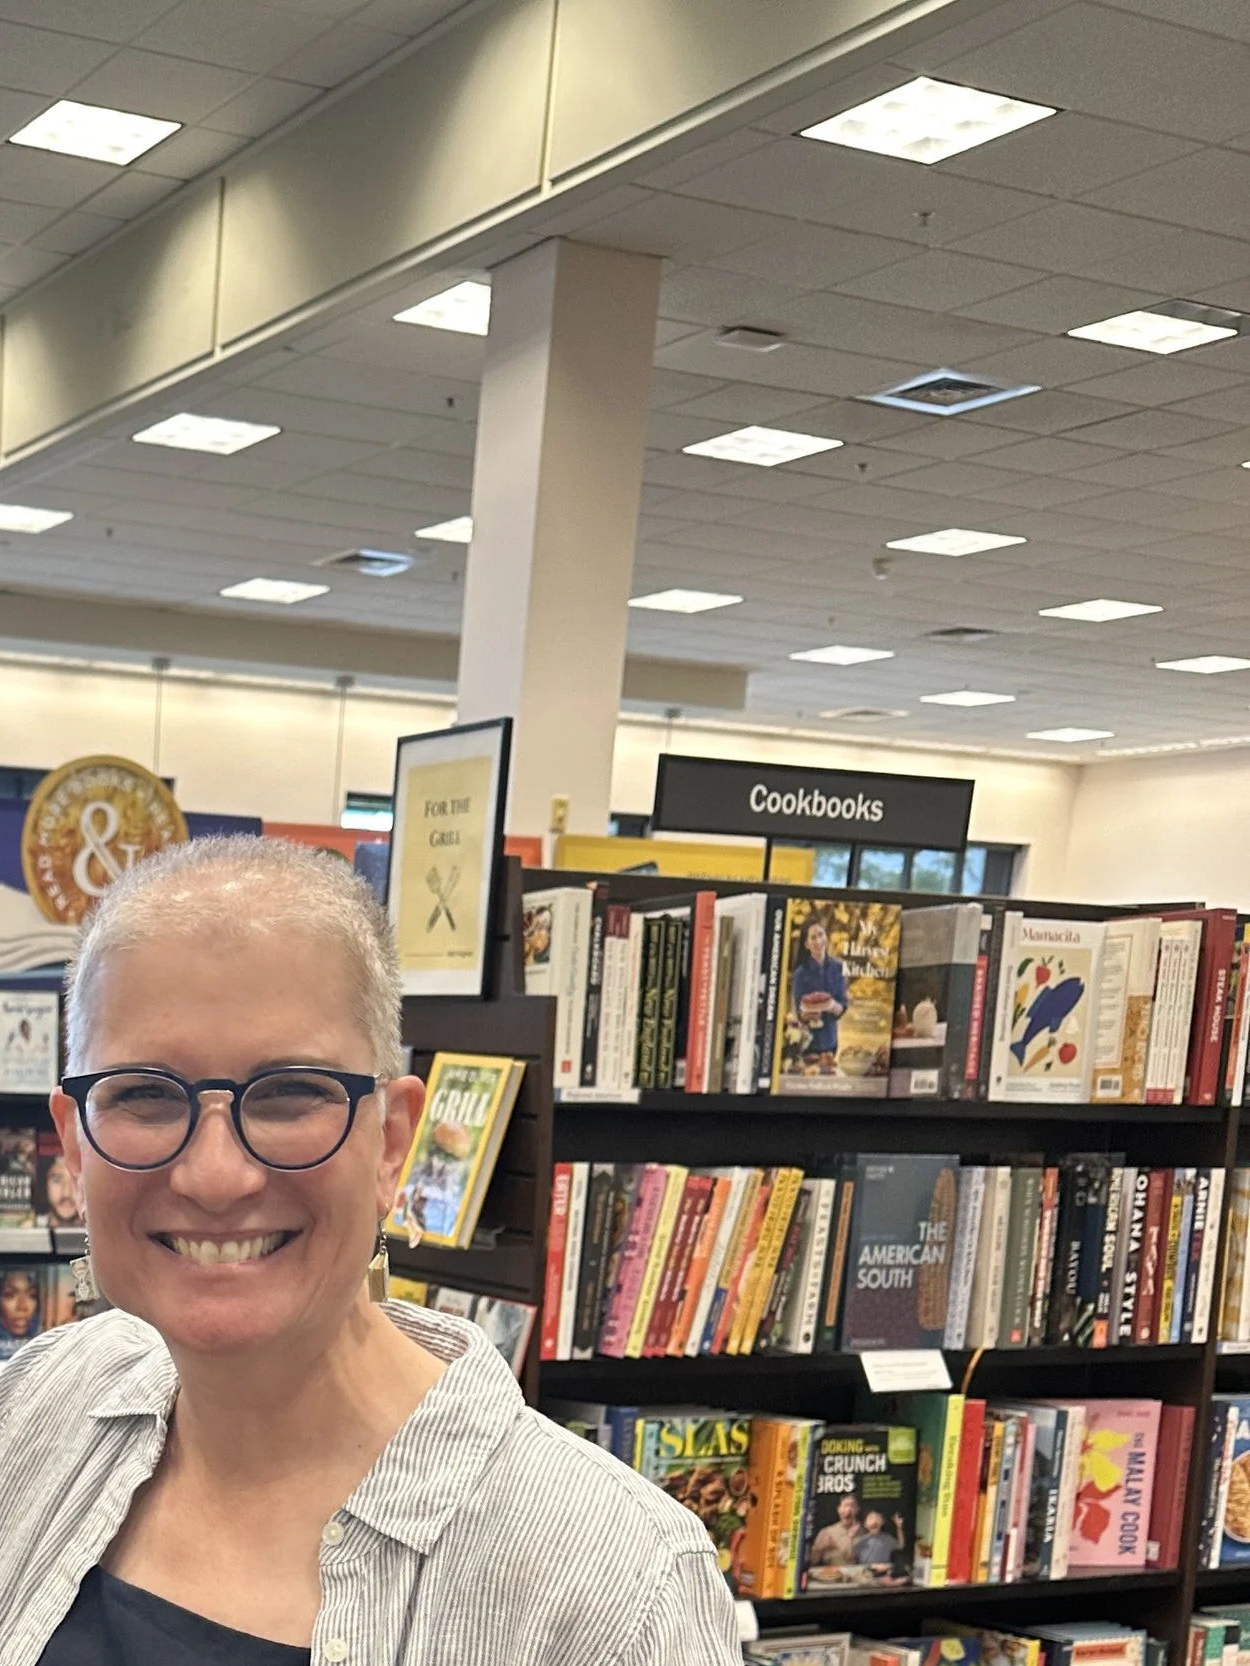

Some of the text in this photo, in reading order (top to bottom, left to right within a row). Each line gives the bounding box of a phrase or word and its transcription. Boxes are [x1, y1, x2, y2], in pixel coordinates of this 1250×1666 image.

[425, 798, 470, 818] FOR THE
[750, 784, 884, 822] Cookbooks
[429, 830, 461, 848] GRILL
[1022, 927, 1081, 944] Mamacita
[768, 932, 780, 982] AMERICAN
[842, 961, 888, 978] Kitchen
[765, 984, 776, 1020] DREAM
[1210, 969, 1227, 1043] STEAK HOUSE
[430, 1087, 490, 1129] GRILL
[552, 1174, 568, 1215] EATER
[919, 1222, 947, 1241] THE
[1102, 1168, 1124, 1272] AMERICAN SOUL
[859, 1245, 946, 1265] AMERICAN
[1066, 1240, 1081, 1295] BAYOU
[1119, 1175, 1148, 1337] OHANA STYLE
[857, 1269, 913, 1289] SOUTH
[824, 1453, 886, 1474] CRUNCH
[1123, 1452, 1146, 1505] MALAY
[1043, 1489, 1057, 1543] IKARIA
[1118, 1511, 1141, 1555] COOK
